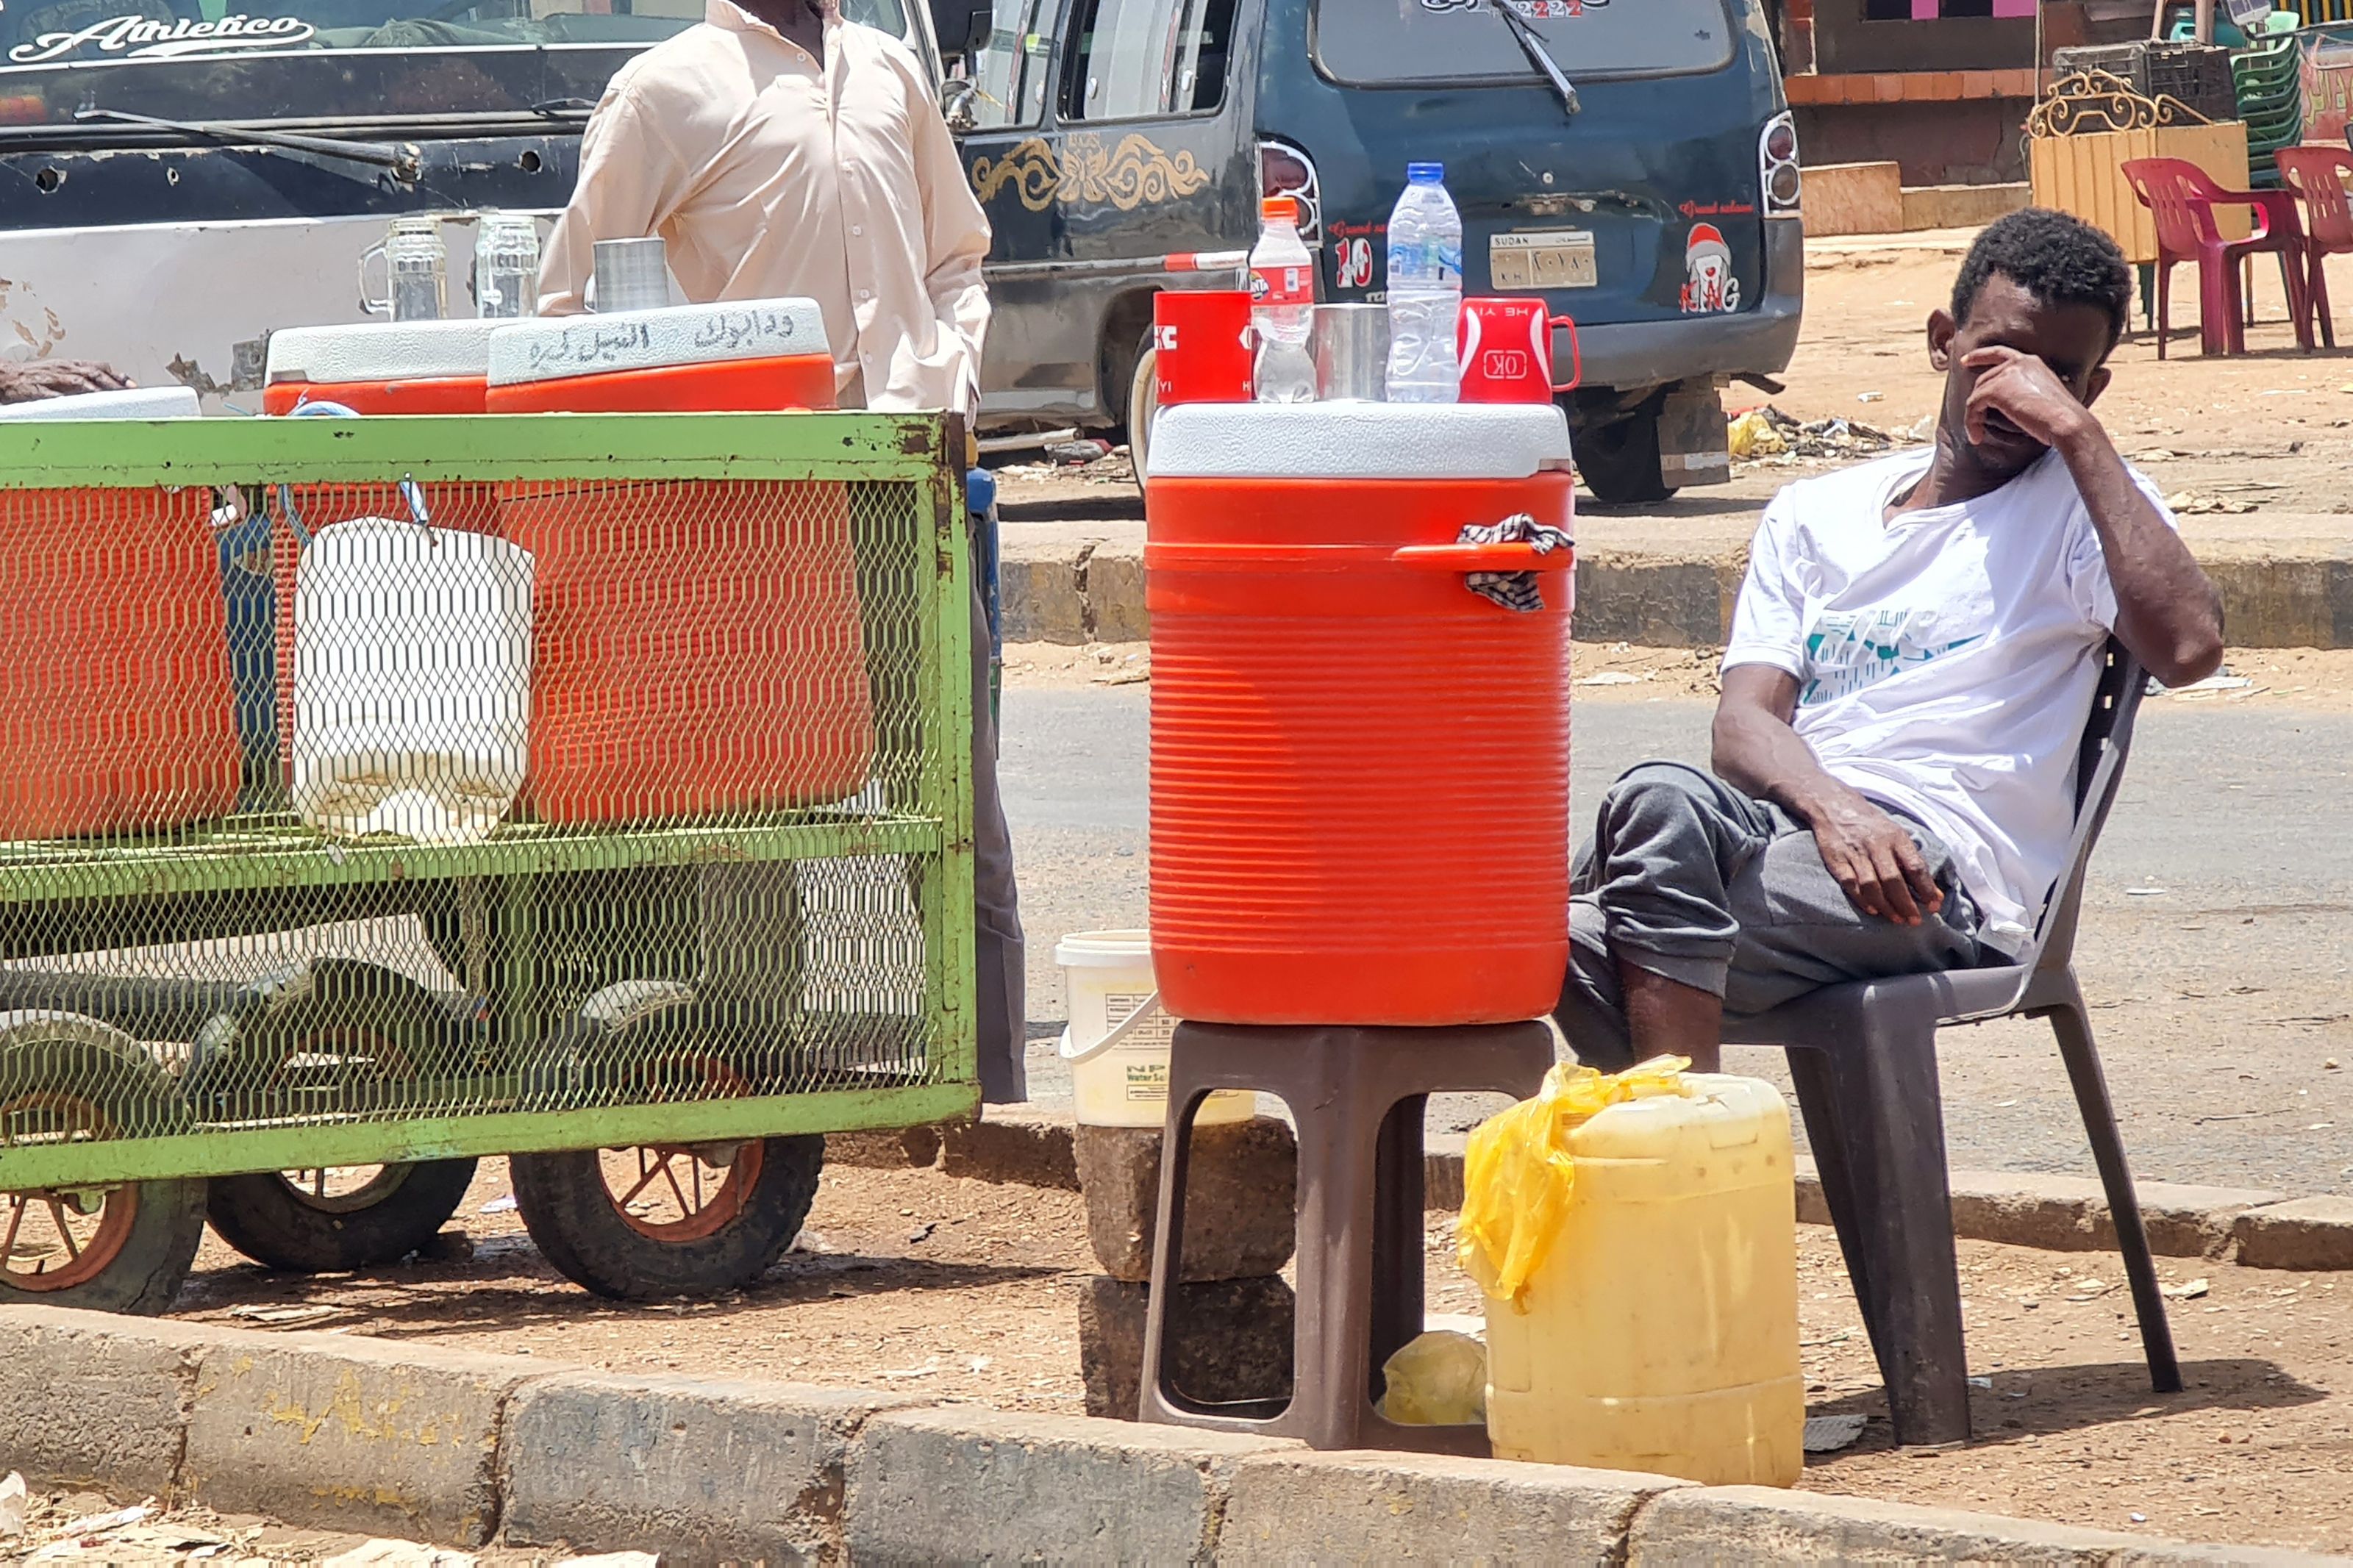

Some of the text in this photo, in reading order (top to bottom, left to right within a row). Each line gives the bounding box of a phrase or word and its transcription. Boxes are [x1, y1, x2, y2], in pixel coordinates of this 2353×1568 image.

[9, 15, 315, 62] Athletico
[1495, 236, 1529, 246] SUDAN
[1492, 355, 1517, 376] OK
